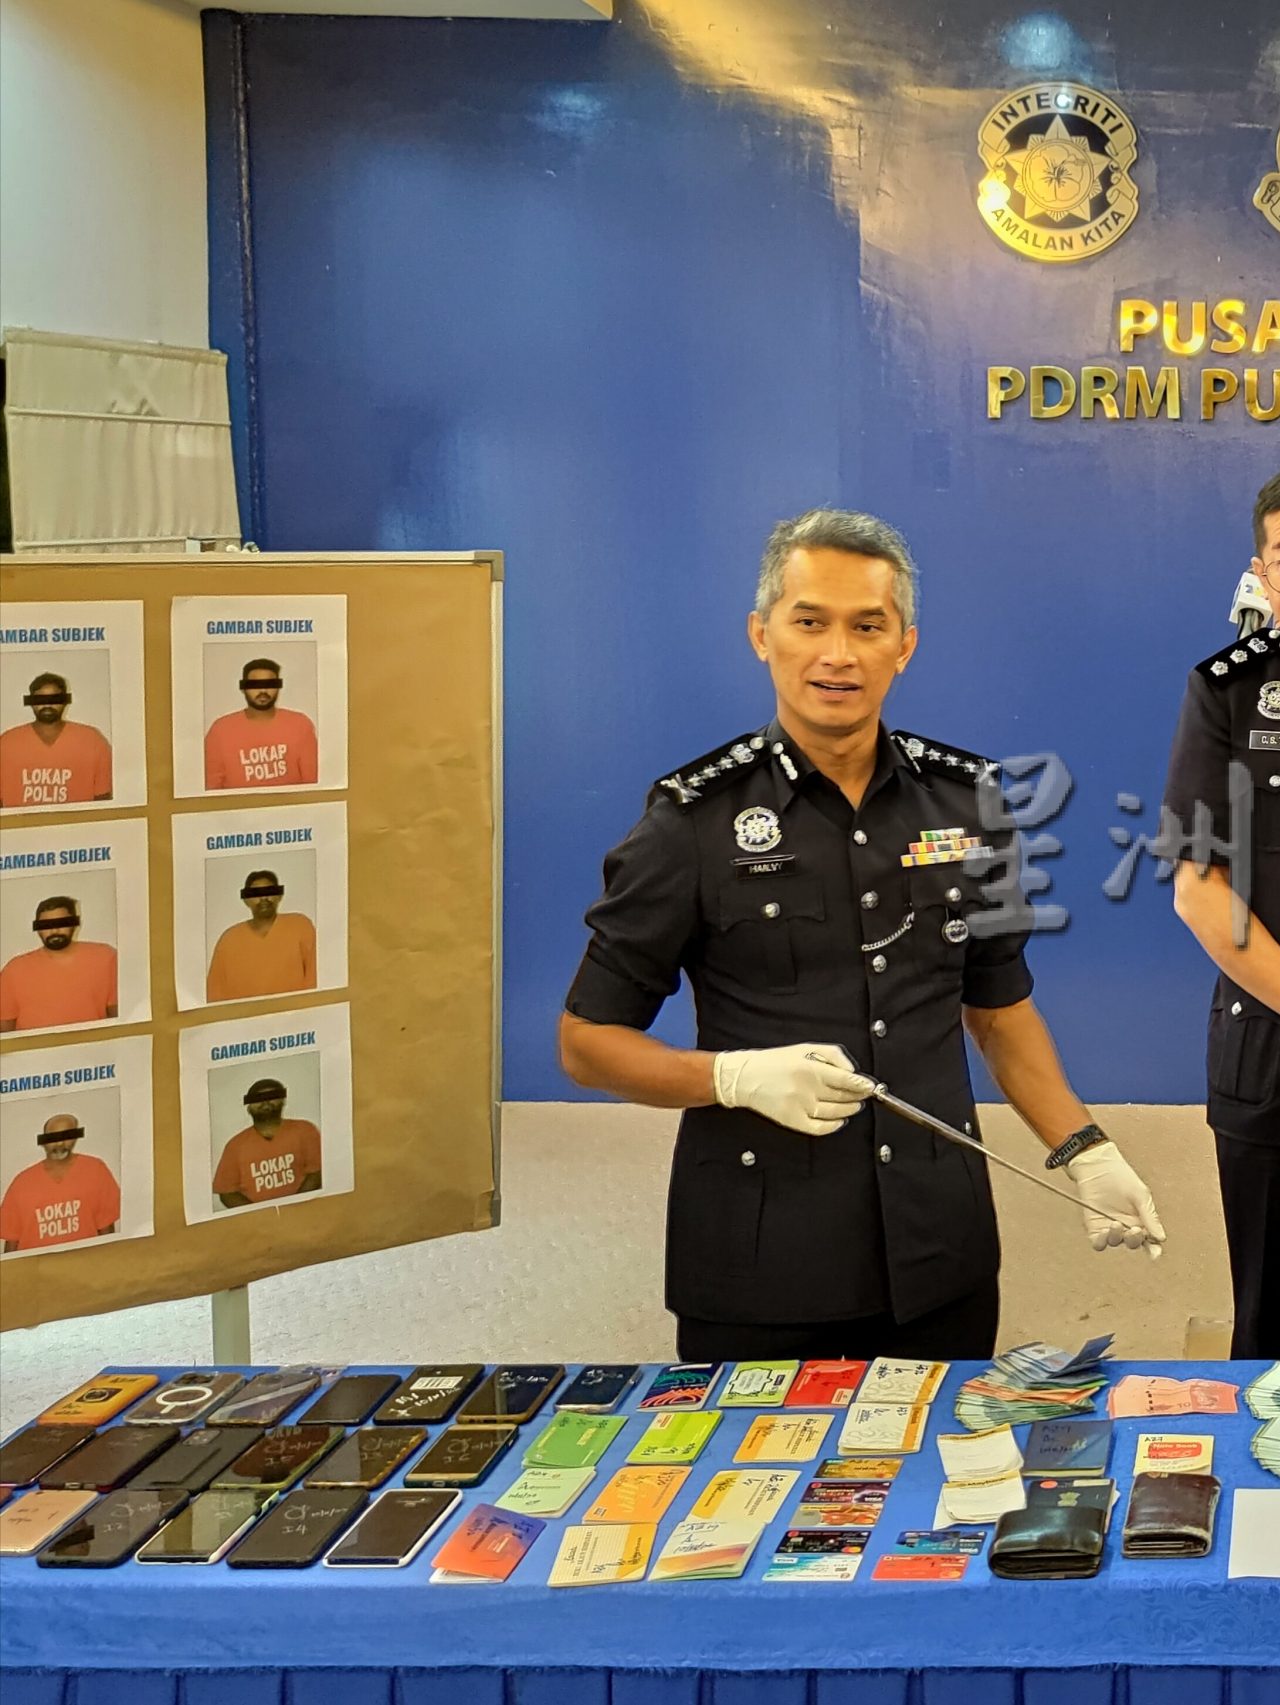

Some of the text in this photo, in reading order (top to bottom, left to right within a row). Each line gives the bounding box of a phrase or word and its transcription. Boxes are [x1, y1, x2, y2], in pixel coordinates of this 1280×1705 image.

[992, 92, 1124, 134] INTEGRITI
[991, 208, 1126, 251] AMALAN KITA
[986, 366, 1180, 420] PDRM
[52, 627, 105, 643] SUBJEK
[207, 619, 313, 635] GAMBAR SUBJEK
[240, 744, 287, 765] LOKAP
[22, 768, 72, 785] LOKAP
[244, 760, 287, 782] POLIS
[23, 786, 67, 803] POLIS
[206, 828, 312, 851] GAMBAR SUBJEK
[60, 847, 111, 865] SUBJEK
[211, 1031, 316, 1061] GAMBAR SUBJEK
[0, 1064, 116, 1094] GAMBAR SUBJEK
[250, 1154, 295, 1179] LOKAP
[255, 1168, 295, 1193] POLIS
[35, 1200, 81, 1223] LOKAP
[38, 1216, 80, 1239] POLIS
